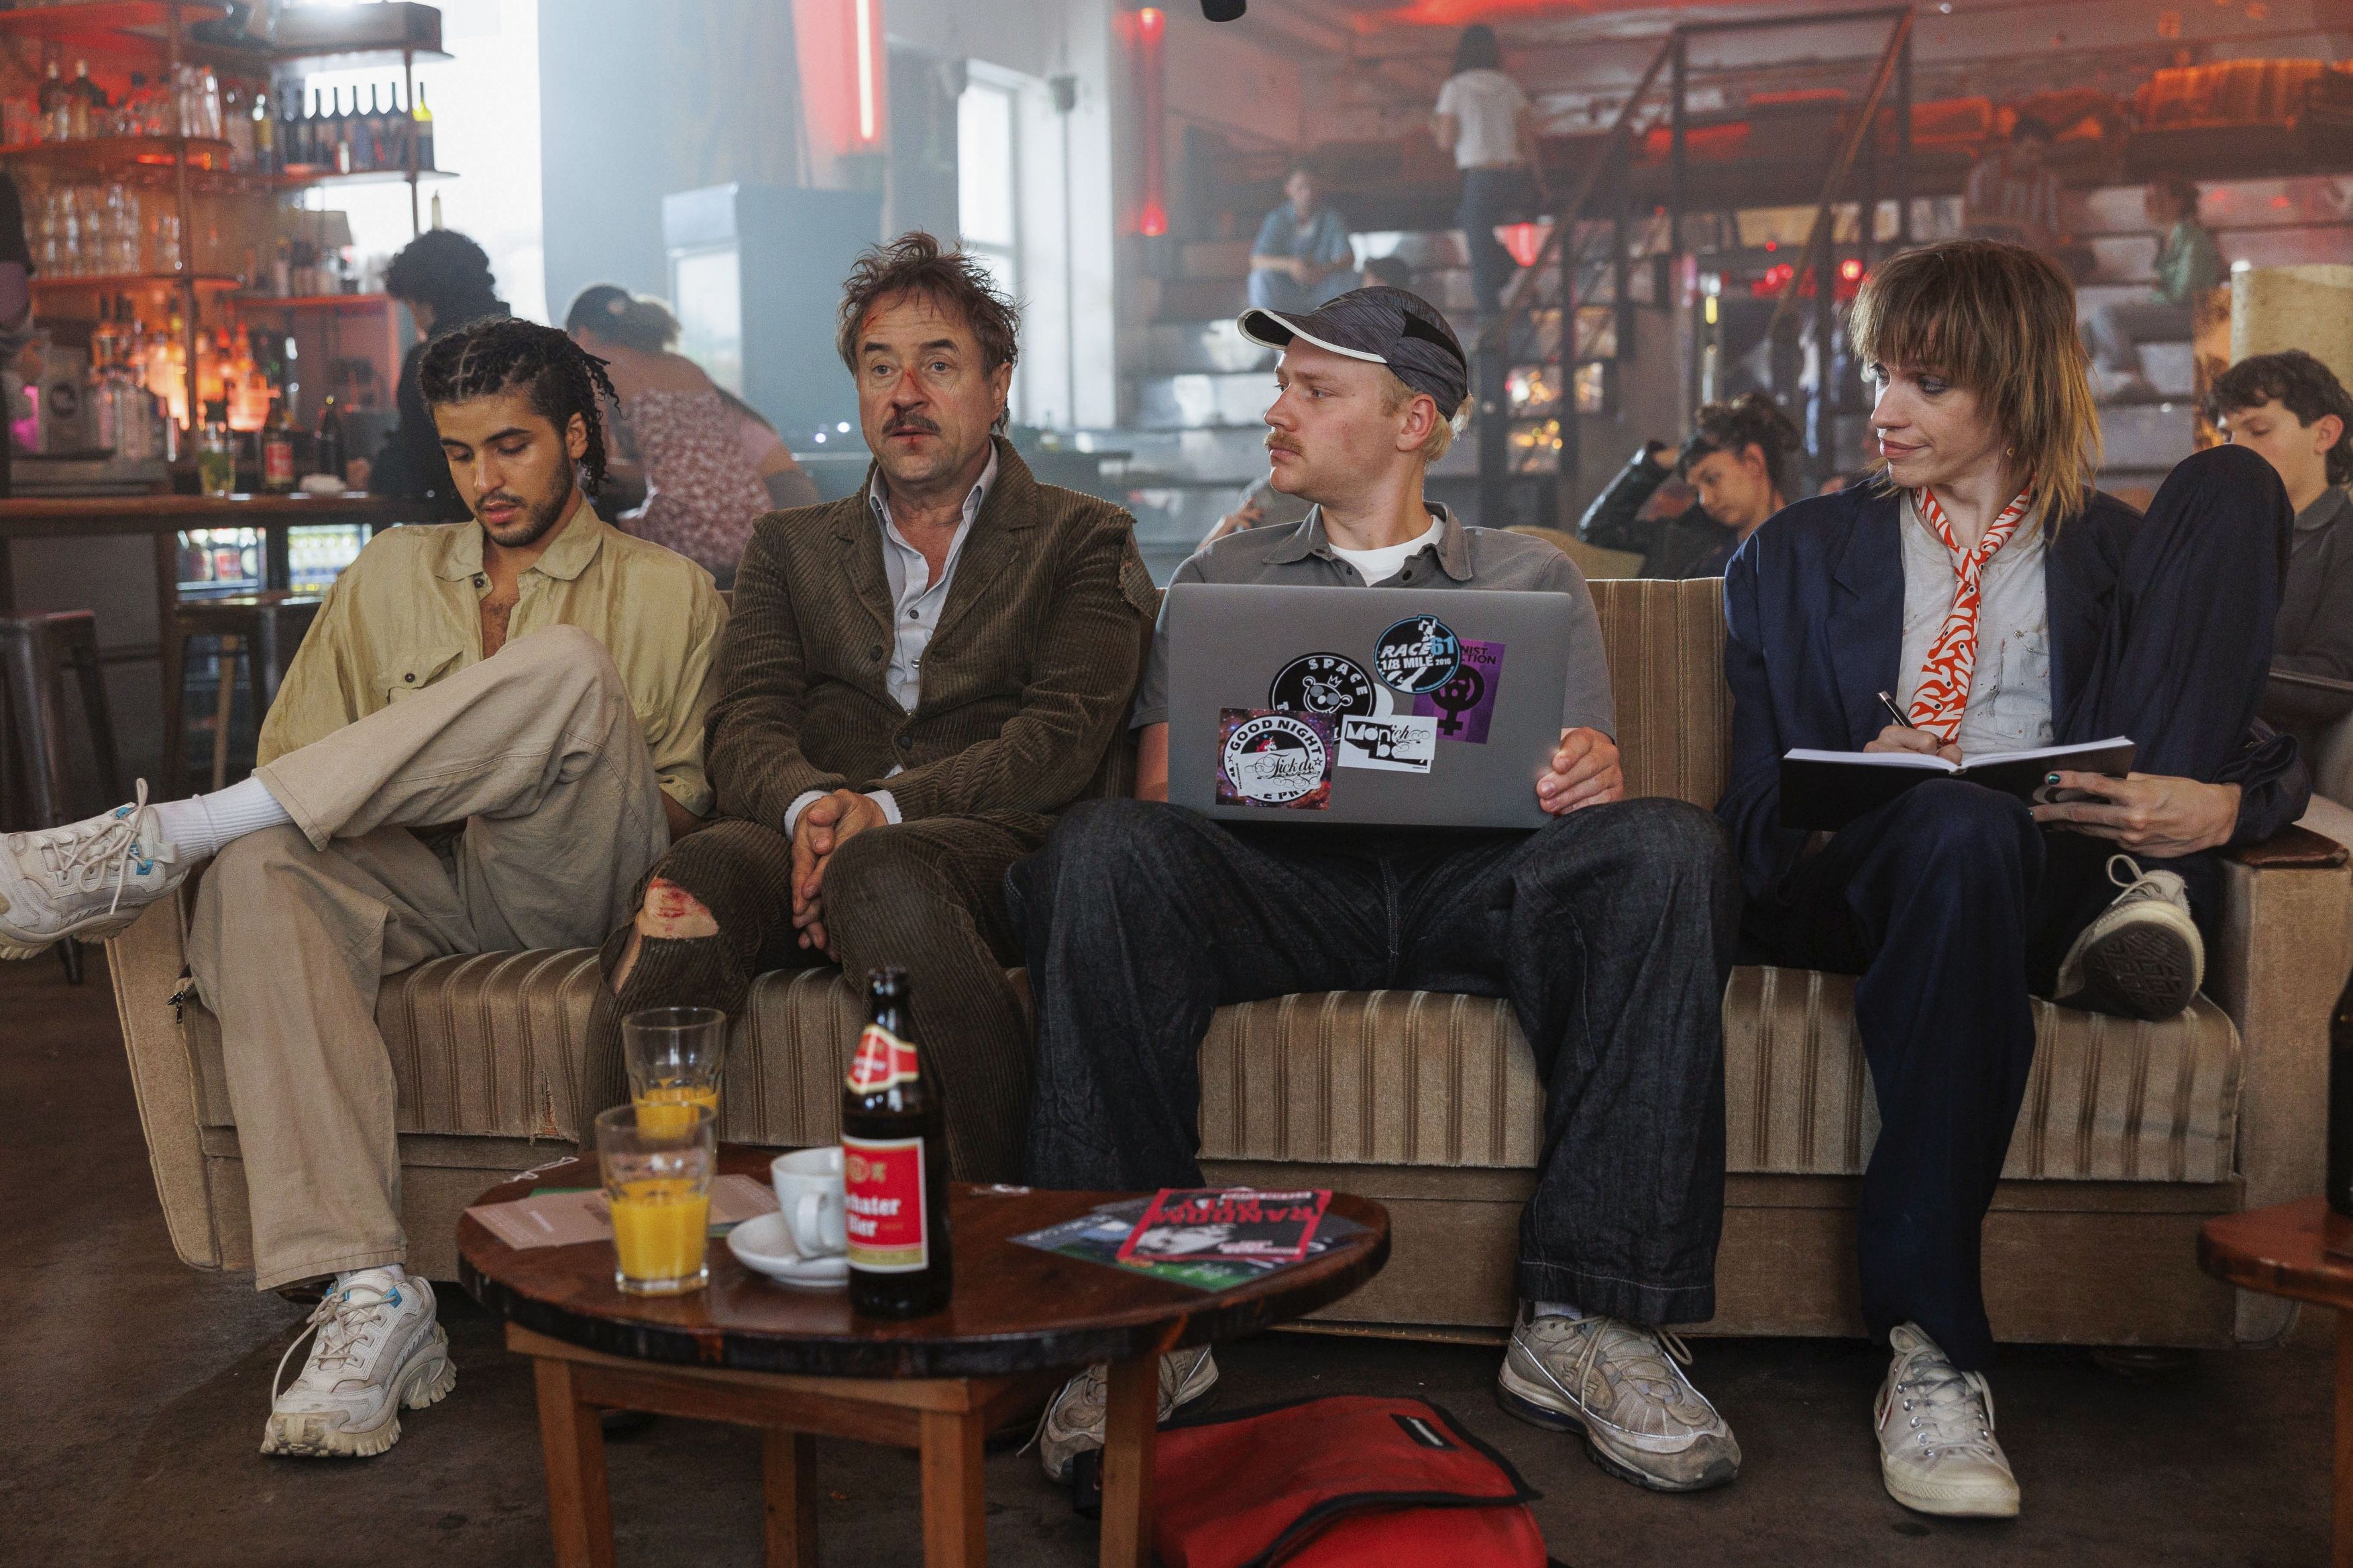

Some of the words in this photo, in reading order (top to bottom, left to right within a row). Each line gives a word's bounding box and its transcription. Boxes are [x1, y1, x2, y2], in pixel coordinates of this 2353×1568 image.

[1380, 642, 1433, 659] RACE
[1380, 658, 1401, 671] 1/8
[1403, 656, 1433, 669] MILE
[1309, 658, 1368, 696] SPACE
[1230, 720, 1273, 751] GOOD
[1277, 719, 1323, 755] NIGHT
